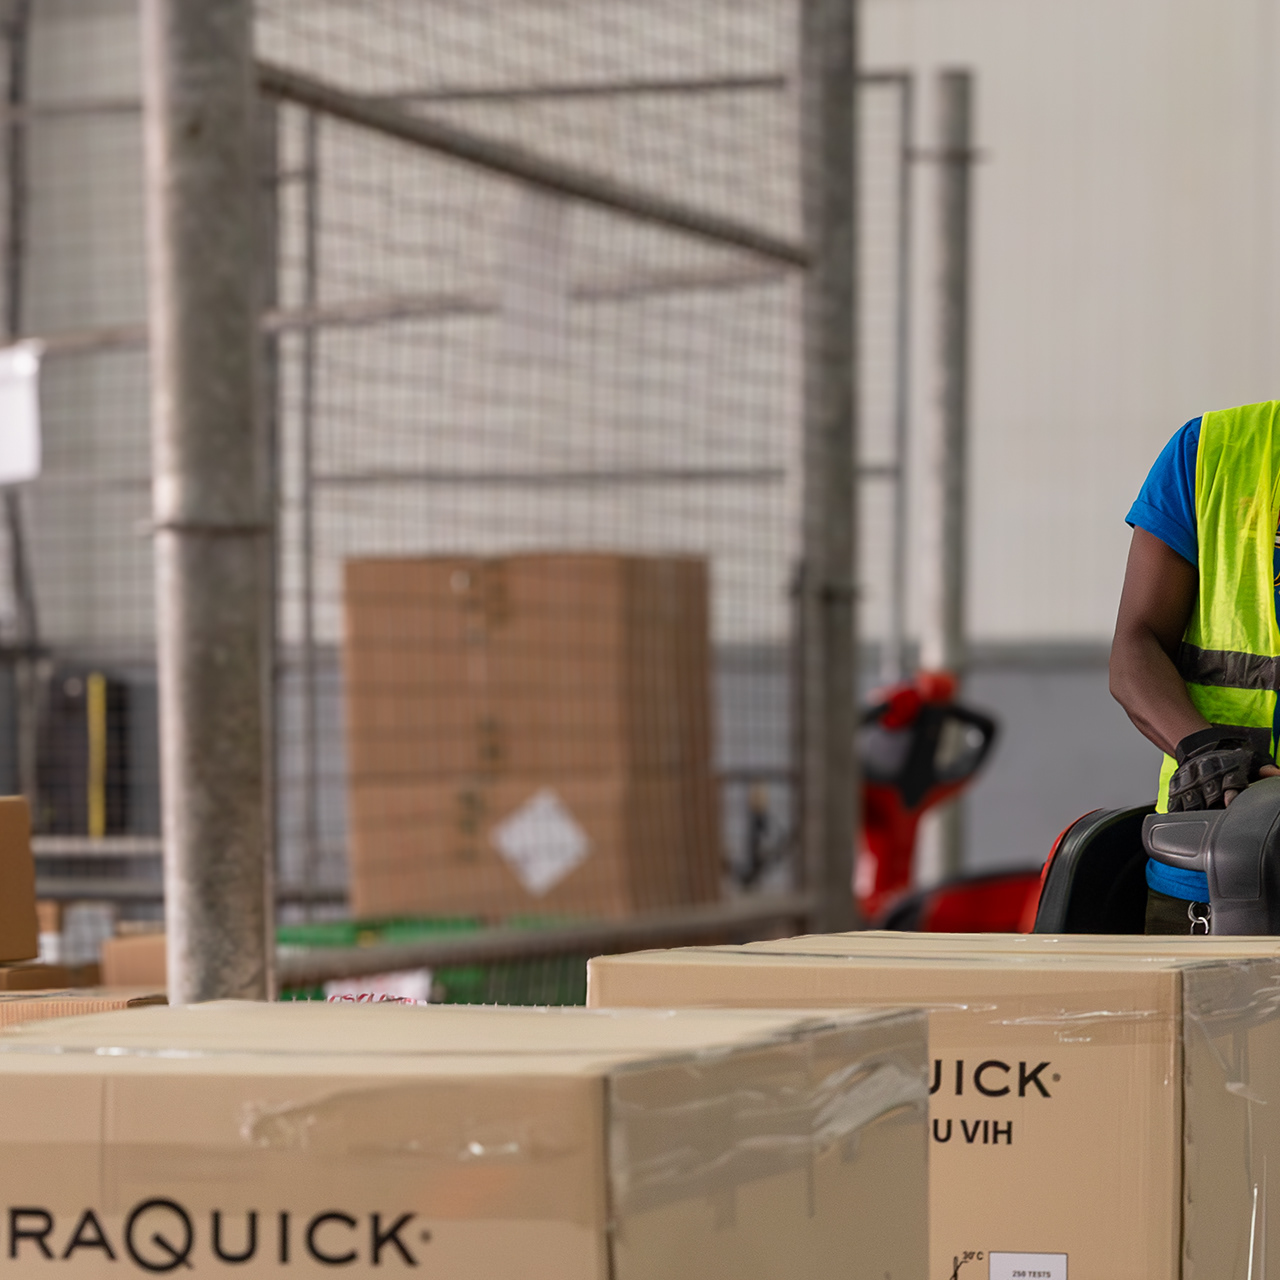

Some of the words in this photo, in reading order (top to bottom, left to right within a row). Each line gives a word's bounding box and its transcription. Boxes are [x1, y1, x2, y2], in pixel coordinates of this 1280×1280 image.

[928, 1118, 952, 1143] U
[960, 1119, 1013, 1145] VIH
[1012, 1270, 1026, 1279] 250
[1028, 1271, 1051, 1279] TESTS
